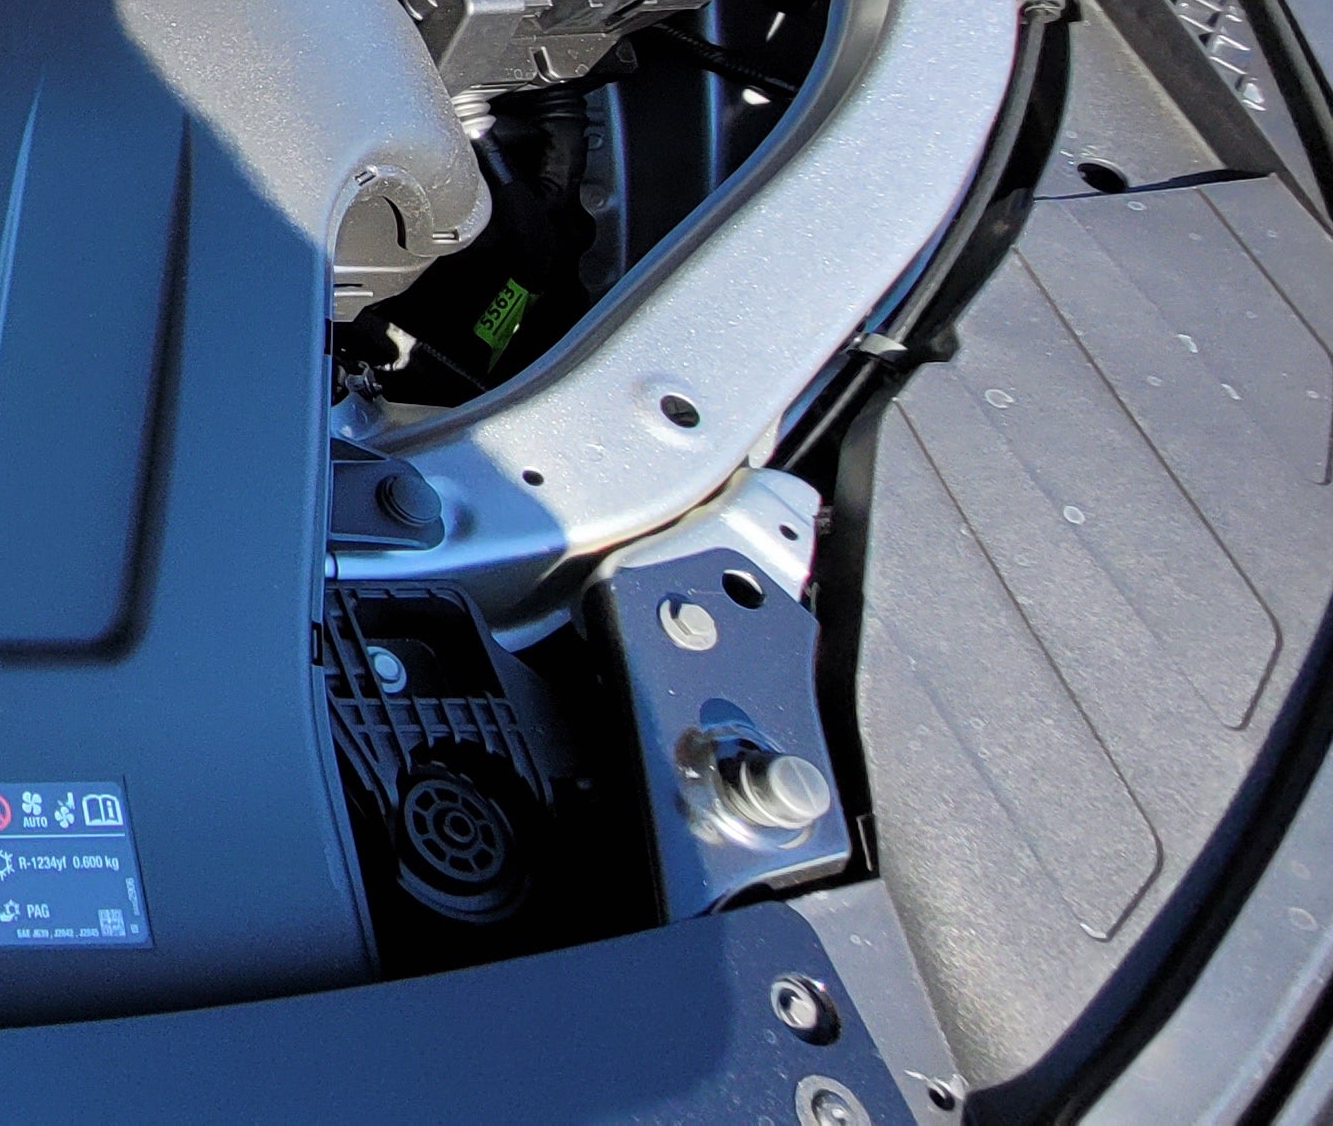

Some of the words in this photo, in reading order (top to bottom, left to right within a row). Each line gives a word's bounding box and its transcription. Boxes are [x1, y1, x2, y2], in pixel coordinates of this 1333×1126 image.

[480, 285, 515, 331] 5563
[23, 816, 48, 828] AUTO
[18, 856, 67, 872] R-1234yf
[73, 855, 102, 869] 0.600
[105, 855, 120, 871] kg
[26, 904, 50, 919] PAG
